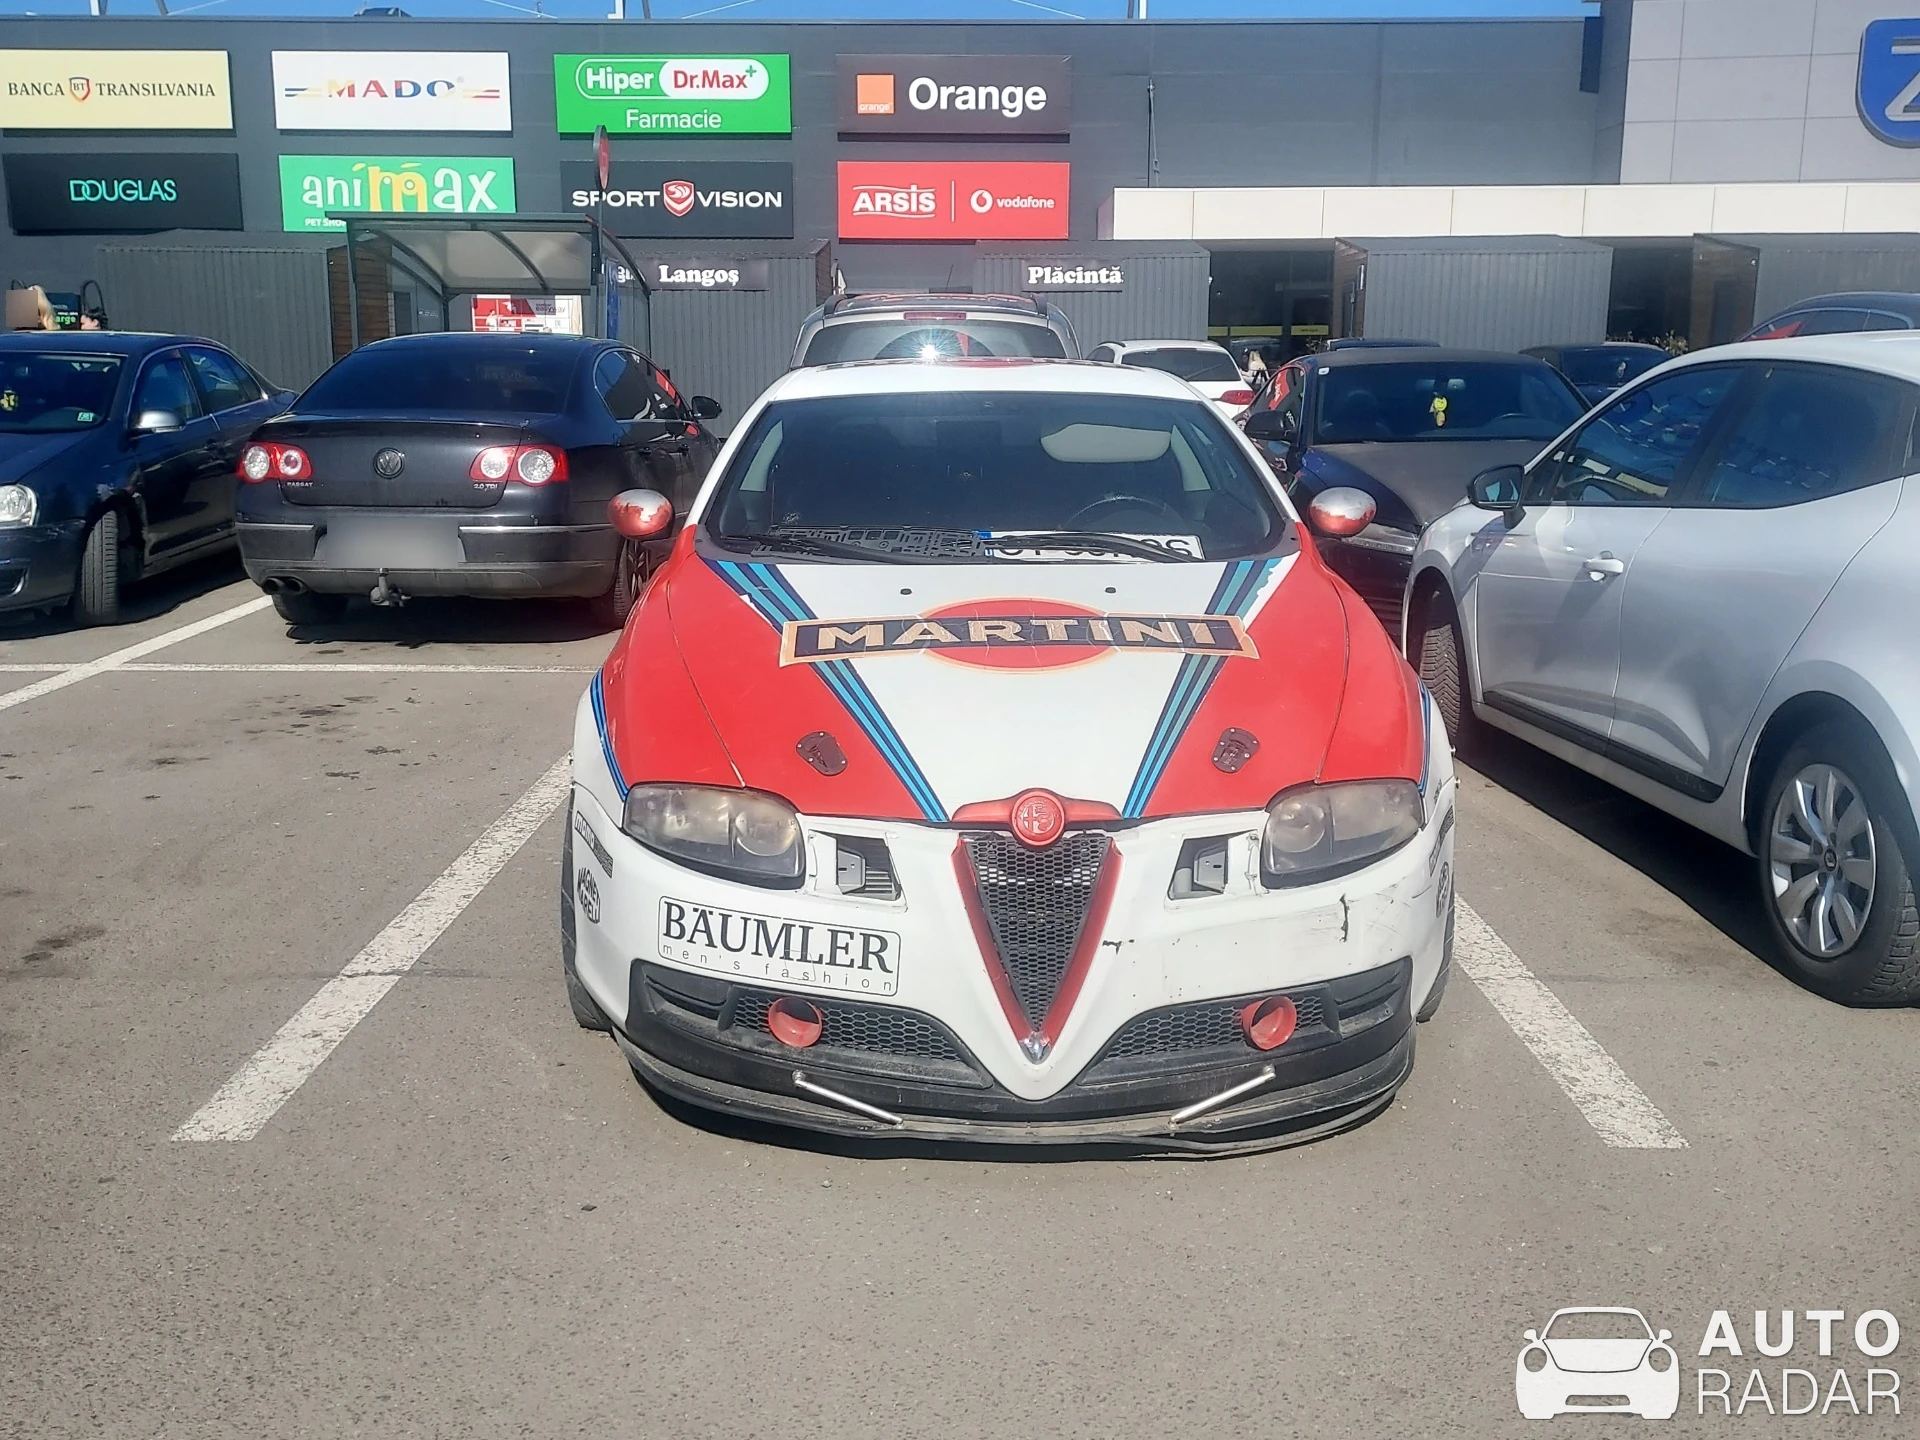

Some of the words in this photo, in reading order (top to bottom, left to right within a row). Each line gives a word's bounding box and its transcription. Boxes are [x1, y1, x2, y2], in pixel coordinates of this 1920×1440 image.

[8, 82, 65, 96] BANCA
[95, 82, 215, 97] TRANSILVANIA
[327, 79, 456, 98] MADO
[586, 66, 654, 94] Hiper
[908, 77, 1047, 118] Orange
[625, 108, 722, 129] Farmacie
[859, 104, 891, 113] orange
[69, 178, 178, 201] DOUGLAS
[572, 190, 661, 207] SPORT
[696, 191, 783, 208] VISION
[996, 195, 1055, 209] vodafone
[304, 217, 321, 227] PET
[817, 618, 1218, 650] MARTINI
[662, 901, 894, 974] BÄUMLER
[662, 943, 742, 971] men's
[764, 962, 893, 992] fashion
